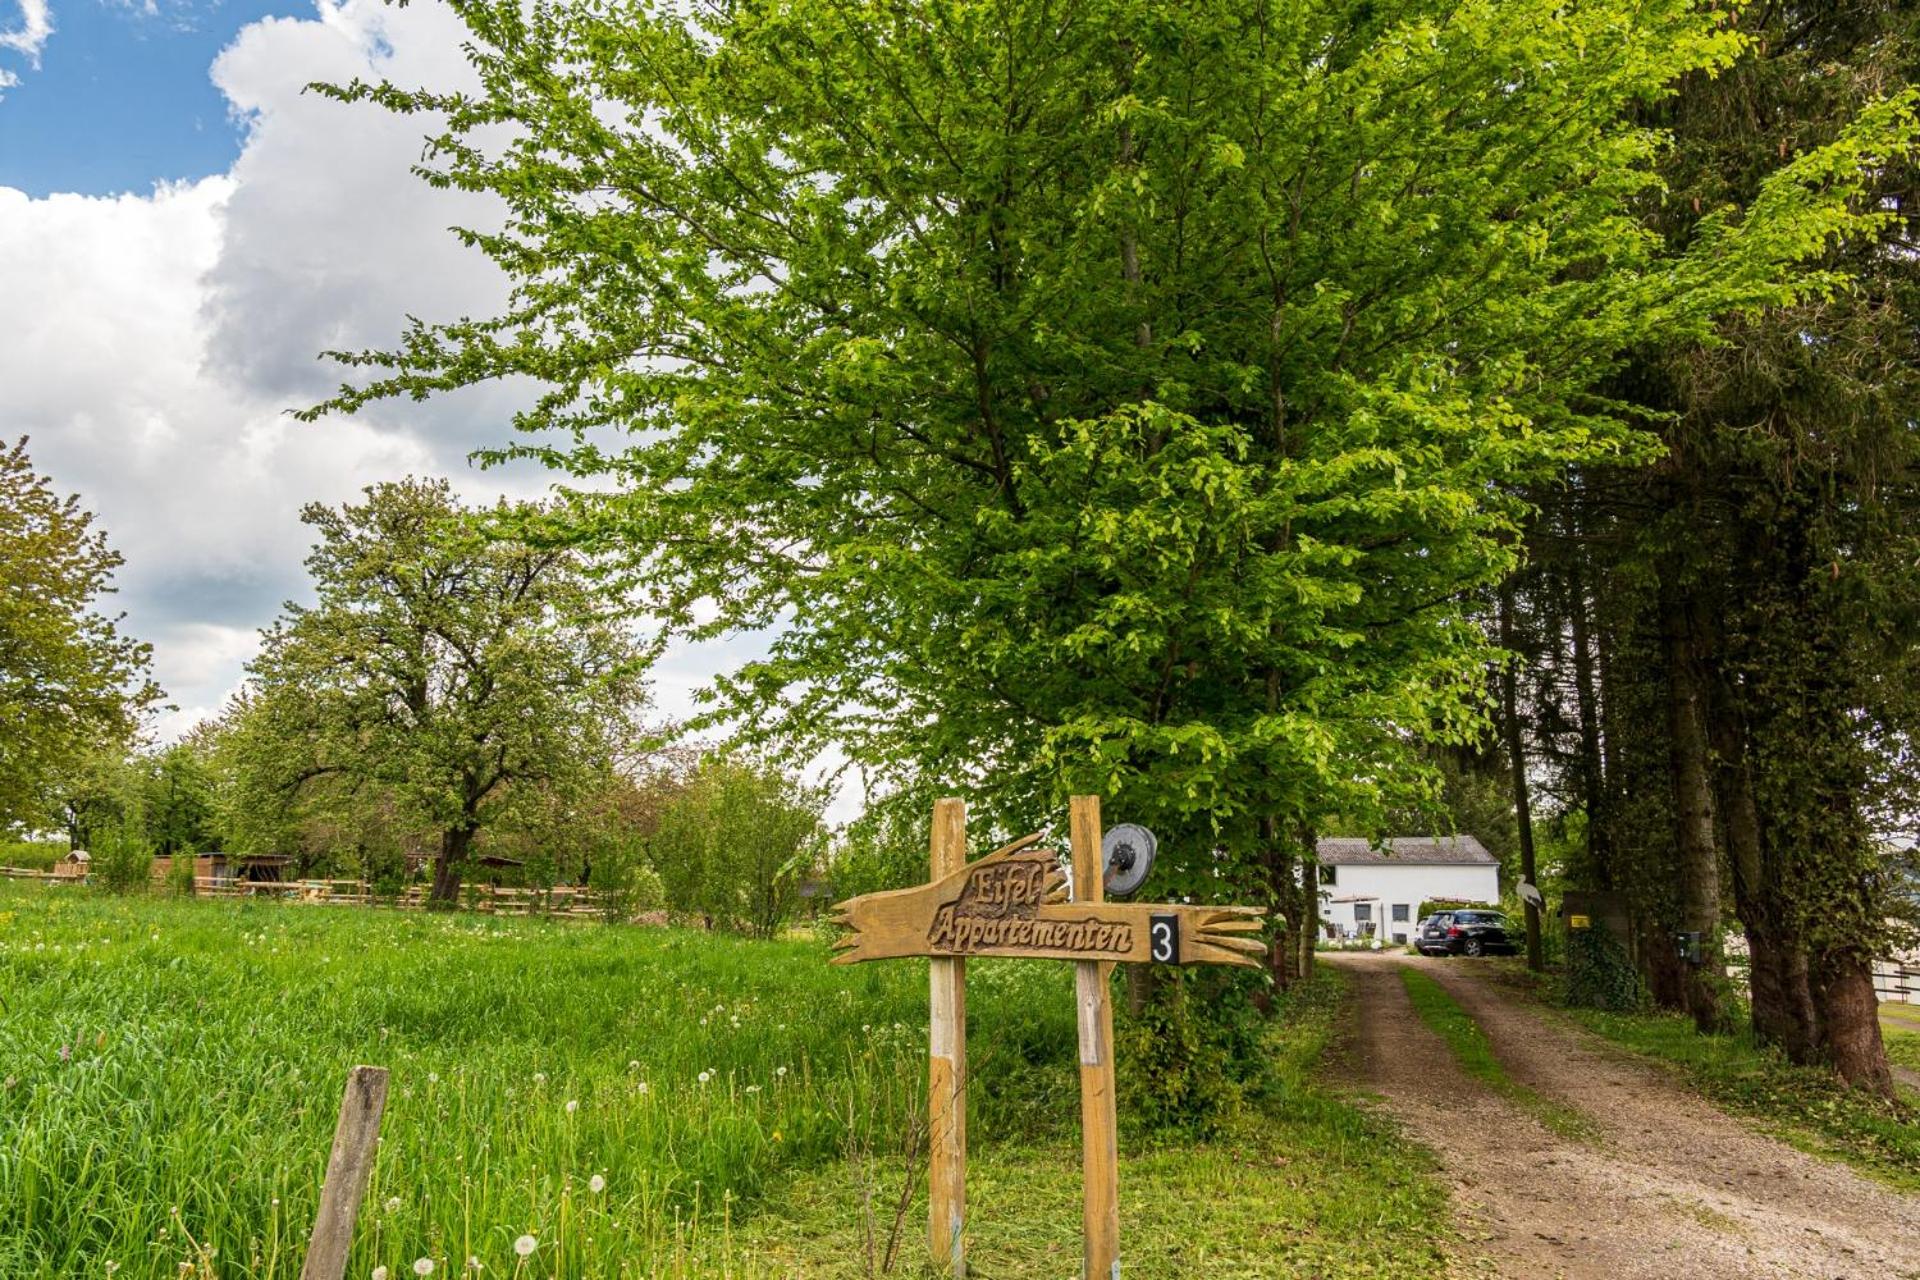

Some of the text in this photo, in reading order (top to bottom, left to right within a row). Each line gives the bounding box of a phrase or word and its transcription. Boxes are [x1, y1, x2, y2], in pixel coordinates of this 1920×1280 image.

[971, 862, 1041, 919] Eifel
[929, 906, 1133, 953] Appartementen
[1152, 922, 1172, 961] 3
